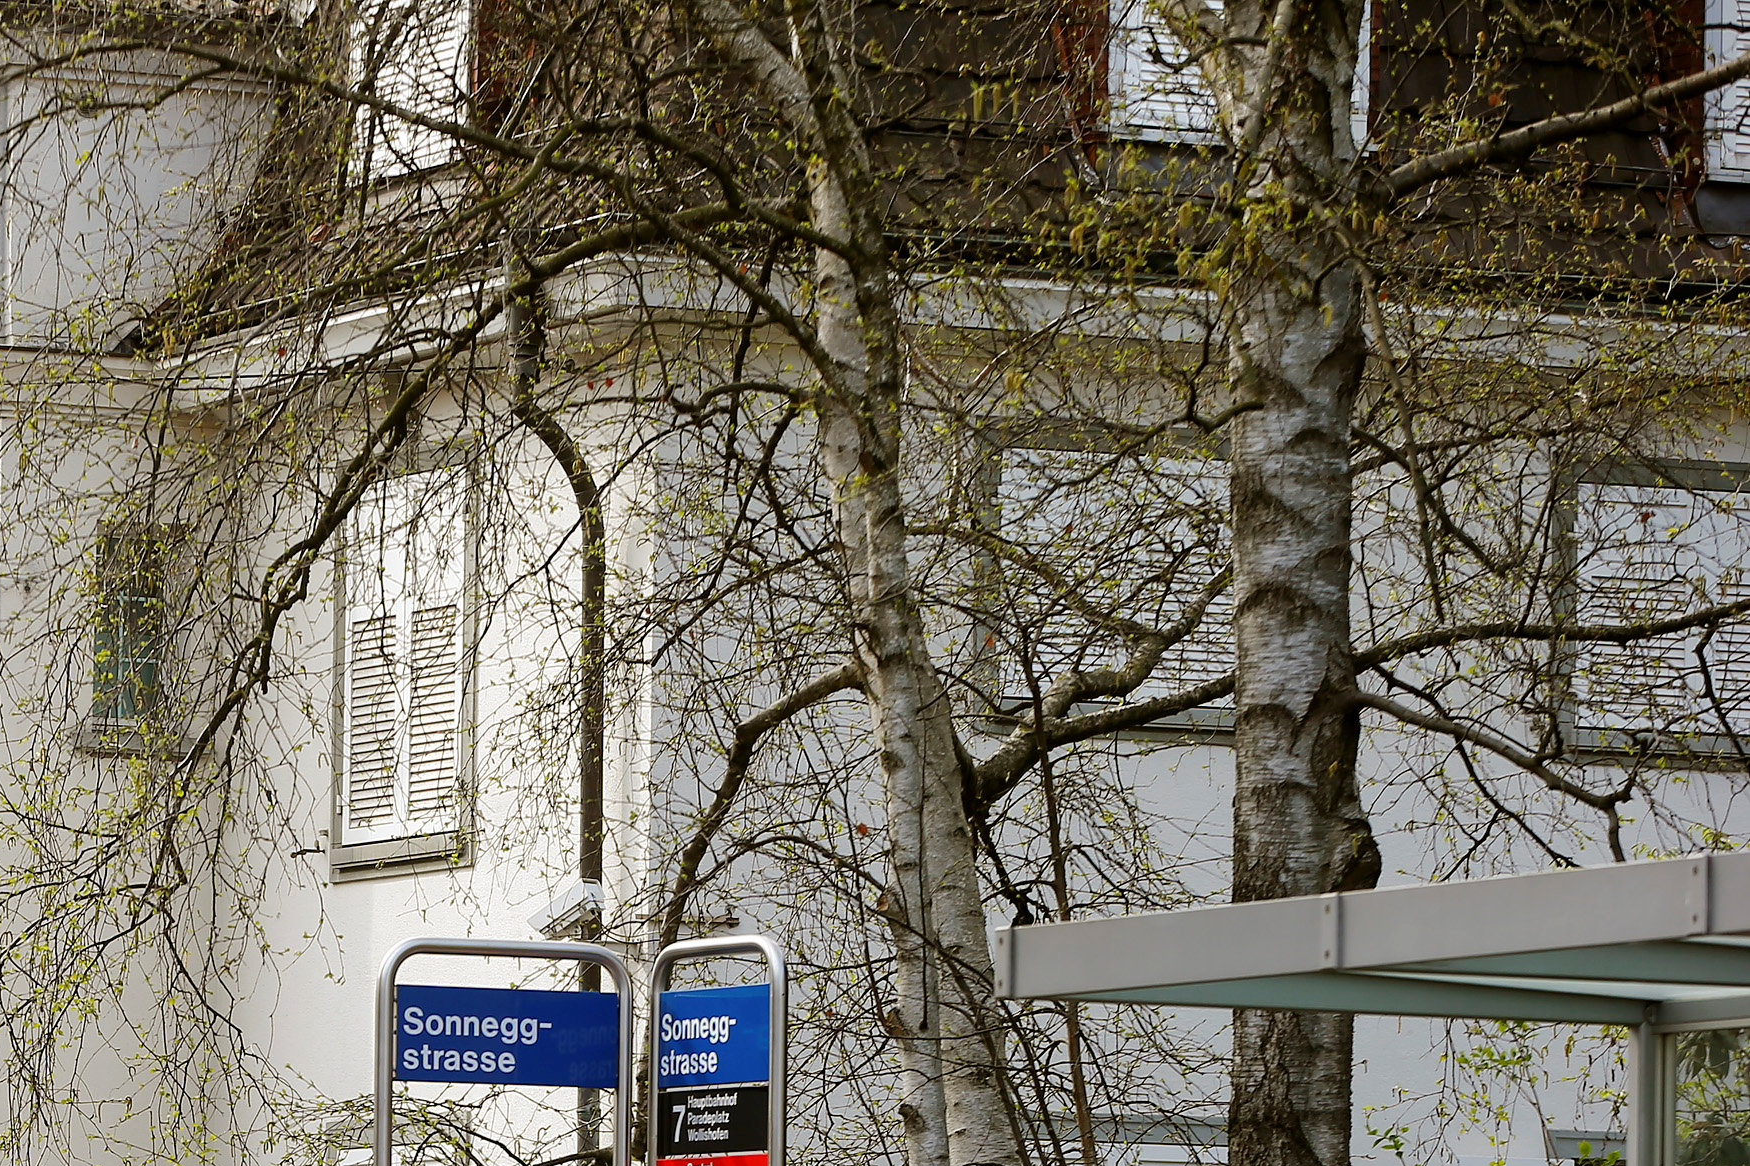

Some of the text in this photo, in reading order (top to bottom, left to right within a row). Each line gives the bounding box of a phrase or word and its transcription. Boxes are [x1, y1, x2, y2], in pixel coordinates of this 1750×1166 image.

[403, 1006, 552, 1045] Sonnegg-
[661, 1013, 737, 1044] Sonnegg-
[403, 1044, 516, 1073] strasse
[660, 1049, 718, 1076] strasse
[687, 1092, 738, 1110] Hauptbahnhof
[672, 1105, 686, 1142] 7
[687, 1111, 730, 1126] Paradeplatz
[687, 1127, 729, 1142] Wollishofen
